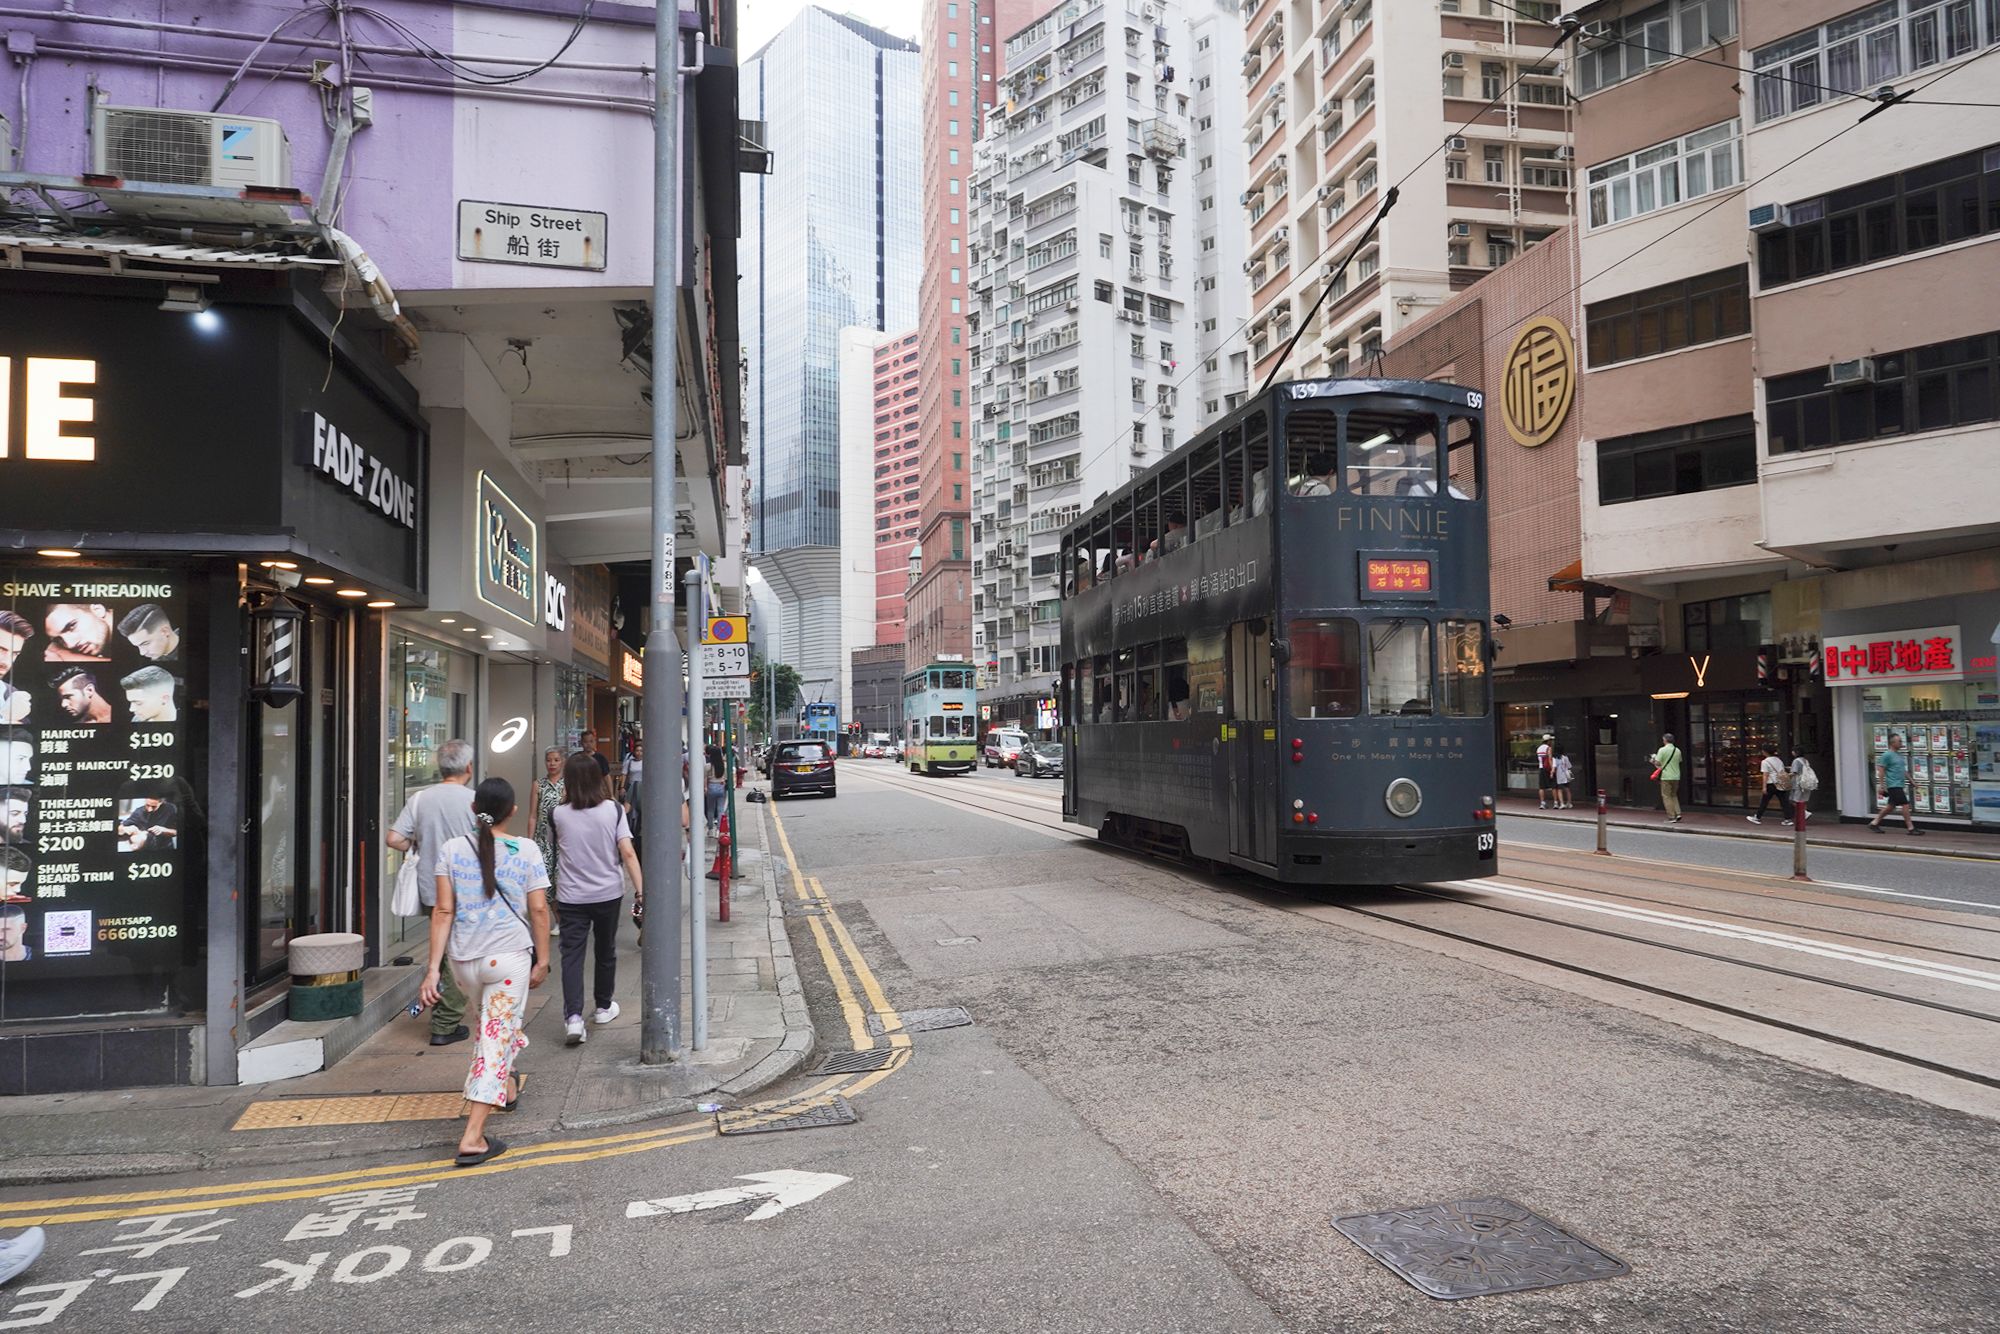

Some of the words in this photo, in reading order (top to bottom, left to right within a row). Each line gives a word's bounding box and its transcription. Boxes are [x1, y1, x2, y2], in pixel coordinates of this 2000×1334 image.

[485, 209, 520, 229] Ship
[530, 213, 582, 231] Street
[507, 235, 560, 259] 船街
[1292, 383, 1318, 399] 139
[1466, 391, 1482, 408] 139
[313, 411, 364, 497] FADE
[368, 455, 415, 529] ZONE
[664, 537, 674, 591] 24783
[1369, 563, 1389, 575] Shek
[1392, 564, 1410, 577] Tong
[1413, 564, 1429, 575] Tsui
[3, 583, 61, 597] SHAVE
[72, 584, 172, 598] THREADING
[1840, 636, 1955, 676] 中原地產
[40, 740, 69, 753] 剪髮
[41, 729, 96, 739] HAIRCUT
[129, 732, 174, 749] $190
[41, 762, 72, 771] FADE
[76, 760, 130, 771] HAIRCUT
[130, 763, 175, 781] $230
[40, 773, 69, 787] 油頭
[39, 798, 113, 809] THREADING
[39, 810, 66, 820] FOR
[67, 809, 96, 819] MEN
[38, 835, 85, 853] $200
[1478, 833, 1494, 850] 139
[37, 863, 79, 874] SHAVE
[128, 862, 173, 880] $200
[37, 873, 80, 884] BEARD
[82, 872, 114, 882] TRIM
[98, 916, 152, 926] WHATSAPP
[97, 925, 178, 941] 66609308
[233, 1224, 574, 1300] LOOK
